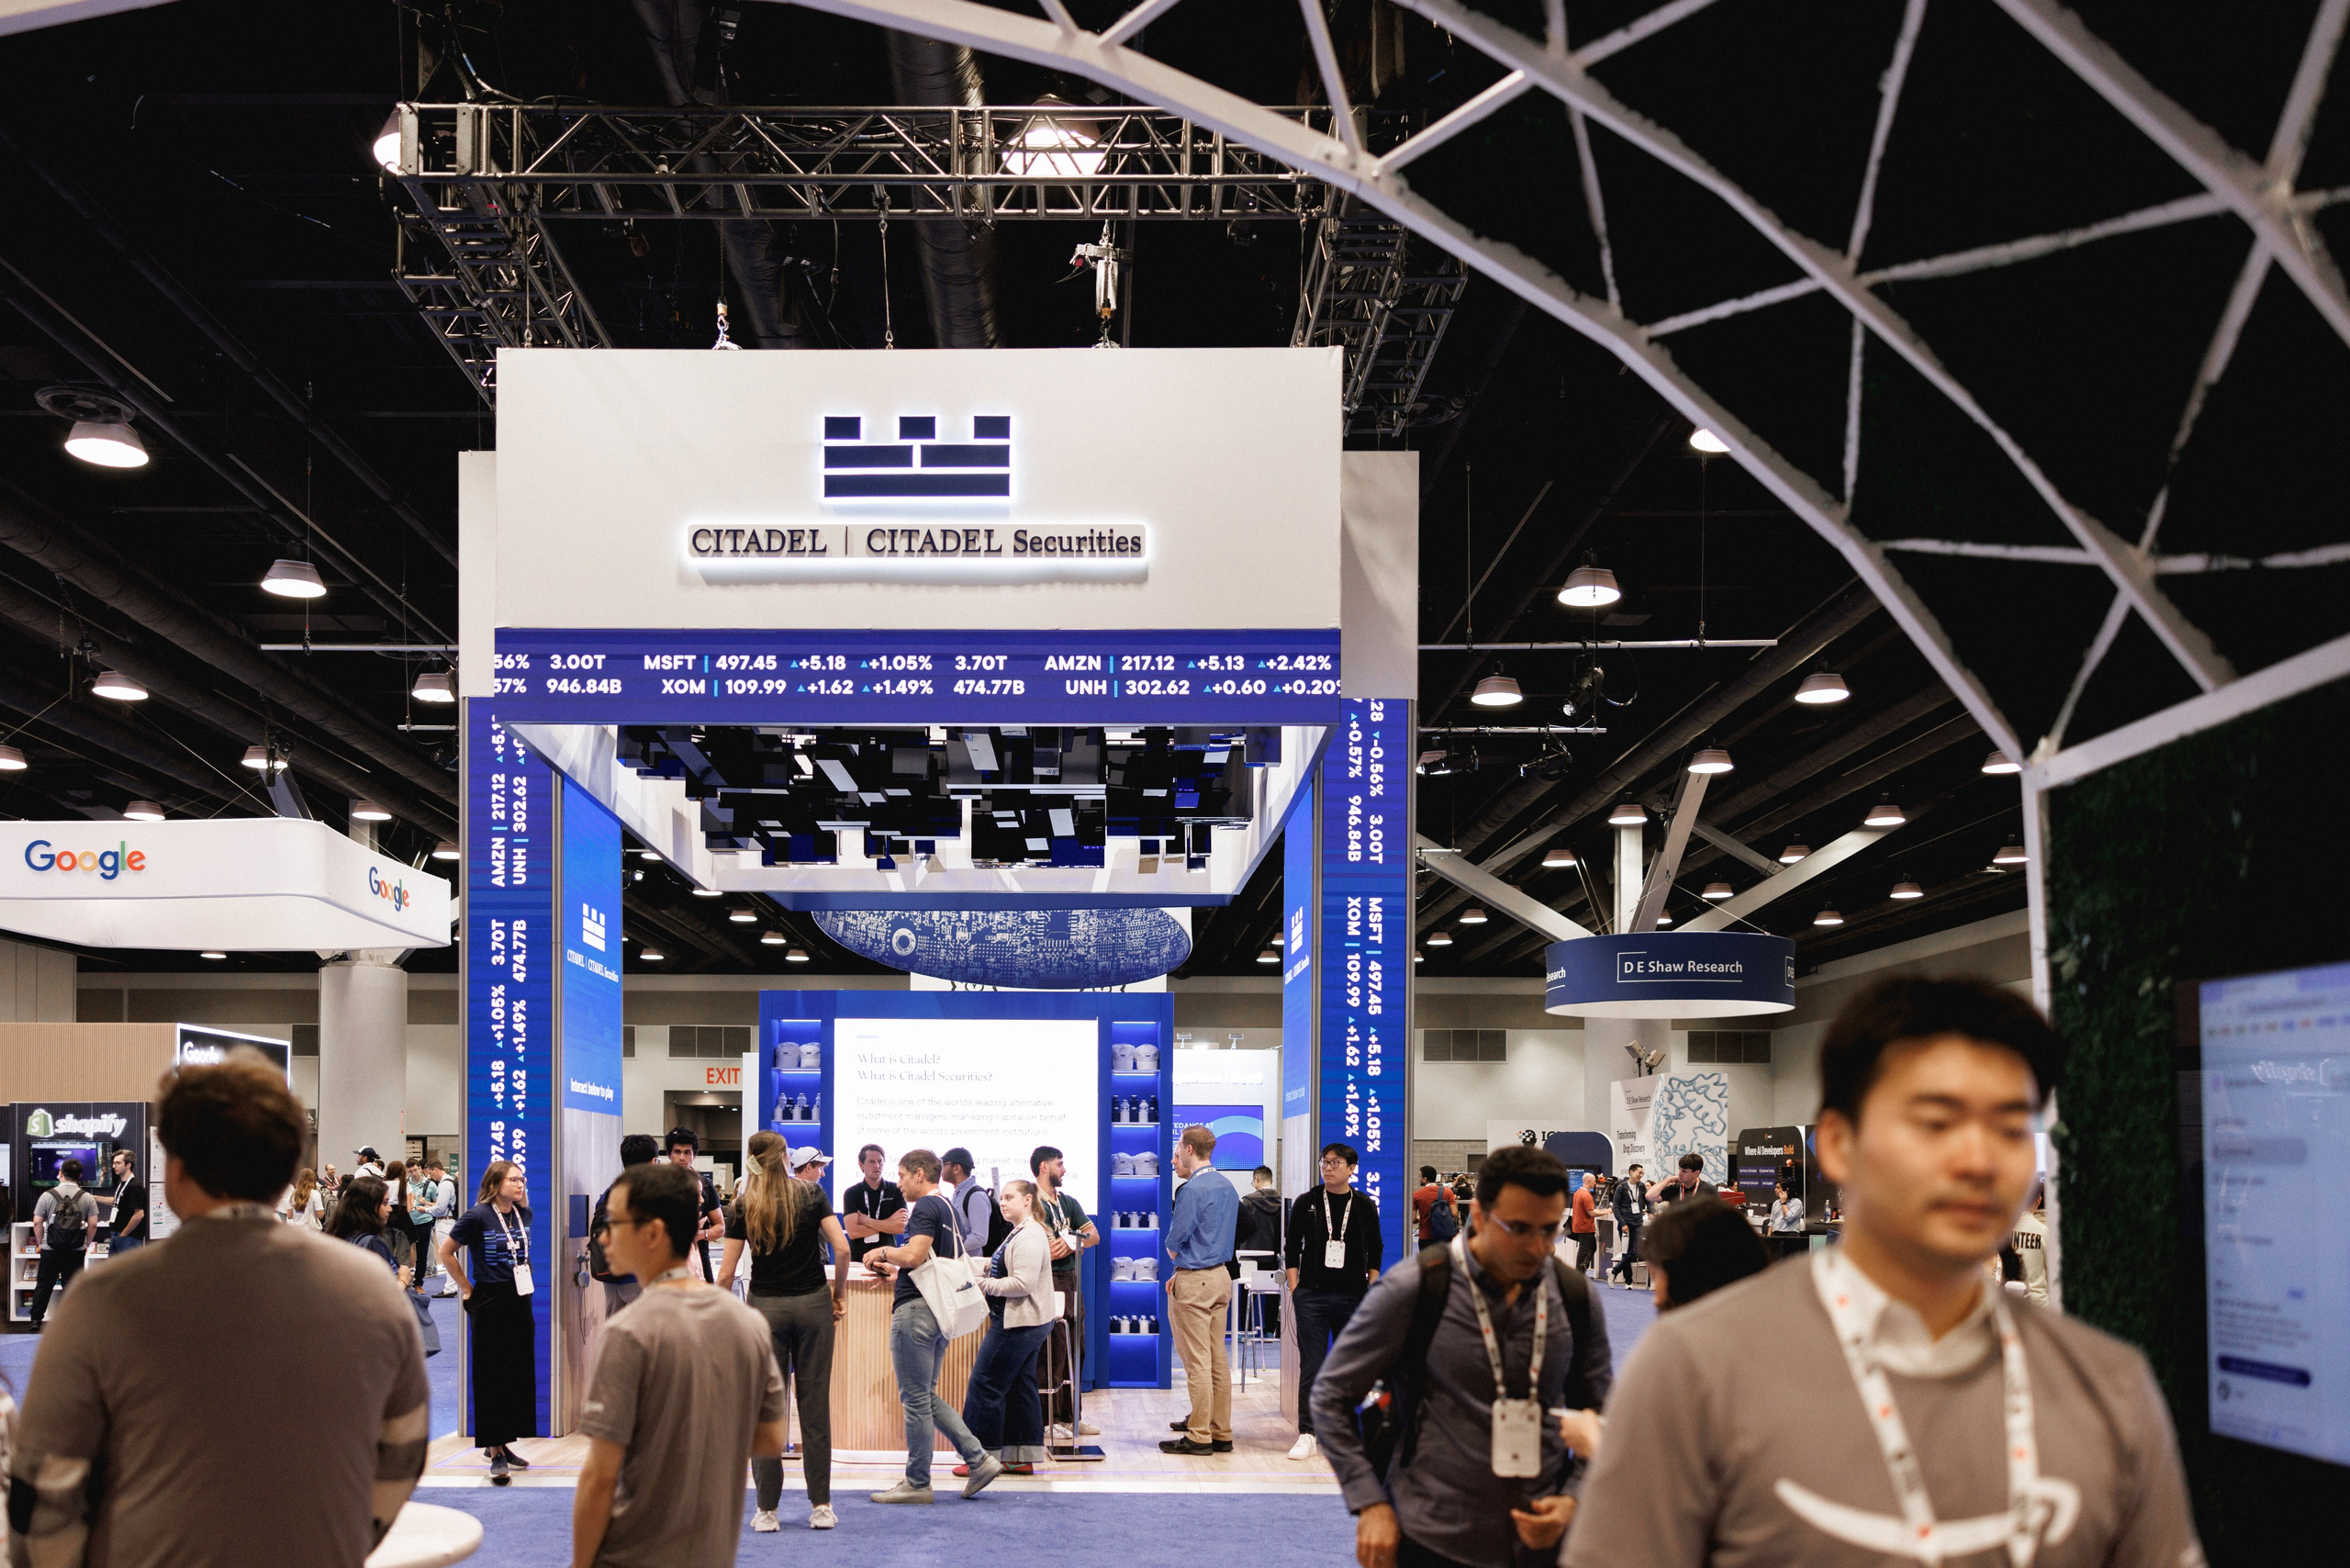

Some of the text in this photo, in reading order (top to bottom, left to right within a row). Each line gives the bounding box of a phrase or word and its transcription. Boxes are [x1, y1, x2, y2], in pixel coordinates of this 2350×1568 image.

[692, 529, 1142, 552] CITADEL CITADEL Securities
[551, 655, 606, 669] 3.00T
[644, 655, 696, 670] MSFT
[716, 655, 778, 670] 497.45
[799, 655, 846, 670] +5.18
[868, 655, 933, 670] +1.05%
[956, 655, 1008, 670] 3.70T
[1045, 655, 1102, 670] AMZN
[1122, 655, 1175, 670] 217.12
[1197, 655, 1245, 670] +5.13
[1267, 655, 1332, 670] +2.42%
[546, 678, 622, 693] 946.84B
[662, 679, 706, 694] XOM
[725, 679, 787, 694] 109.99
[808, 679, 854, 694] +1.62
[873, 680, 934, 694] +1.49%
[954, 679, 1025, 695] 474.77B
[1066, 680, 1107, 695] UNH
[1125, 680, 1190, 695] 302.62
[1212, 680, 1267, 695] +0.60
[1370, 739, 1383, 797] -0.56%
[492, 774, 505, 820] 217.12
[513, 777, 526, 832] 302.62
[25, 840, 146, 880] Google
[1369, 815, 1383, 864] 3.00T
[492, 837, 505, 887] AMZN
[513, 848, 526, 884] UNH
[369, 866, 409, 912] Google
[1346, 721, 1362, 1137] +0.57% 946.84B XOM 109.99 +1.62 +1.49%
[1369, 898, 1382, 944] MSFT
[492, 919, 505, 965] 3.70T
[513, 920, 526, 982] 474.77B
[567, 949, 585, 968] CITADEL
[588, 959, 604, 977] CITADEL
[1624, 960, 1742, 973] D E Shaw Research
[1369, 961, 1382, 1014] 497.45
[491, 985, 505, 1040] +1.05%
[513, 1000, 526, 1053] +1.49%
[706, 1068, 740, 1084] EXIT
[858, 1054, 941, 1064] What is Citadel?
[858, 1070, 992, 1081] What is Citadel Securities?
[1368, 1035, 1381, 1076] +5.18
[491, 1060, 505, 1102] +5.18
[513, 1070, 526, 1111] +1.62
[571, 1078, 588, 1093] Interact
[588, 1081, 600, 1097] below
[54, 1114, 128, 1137] shopify
[856, 1112, 903, 1120] investment
[1367, 1096, 1381, 1152] +1.05%
[491, 1121, 505, 1162] 97.45
[1784, 1145, 1794, 1155] Build
